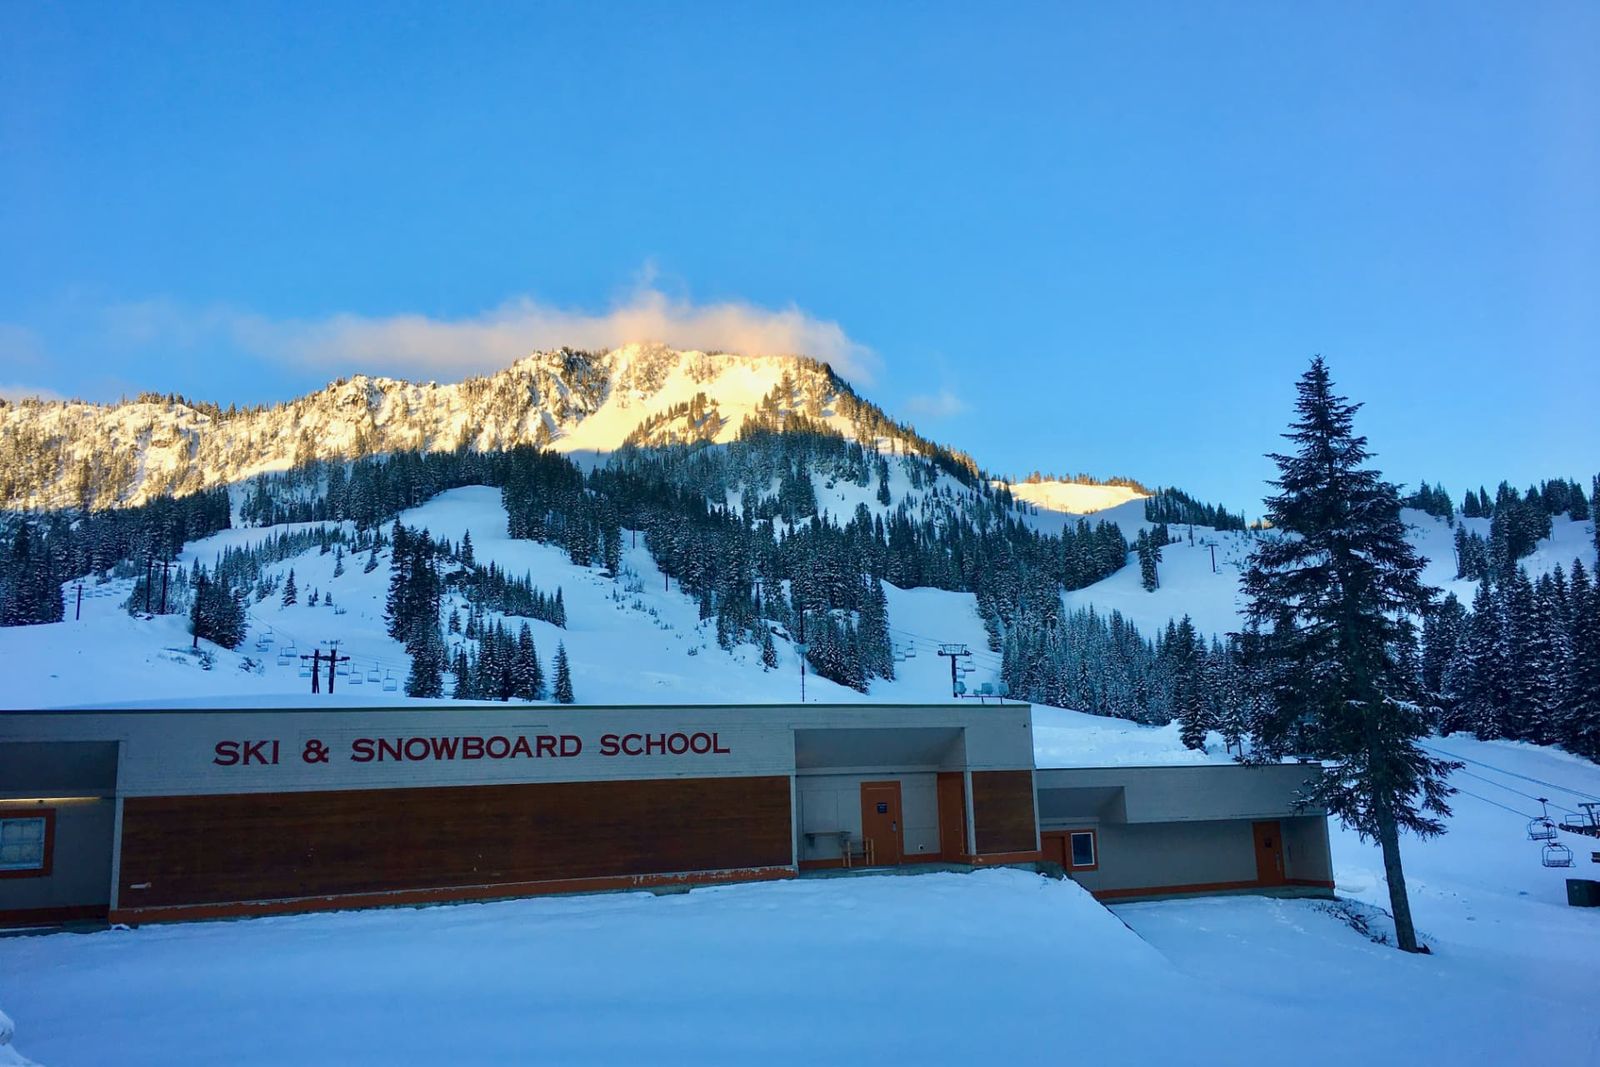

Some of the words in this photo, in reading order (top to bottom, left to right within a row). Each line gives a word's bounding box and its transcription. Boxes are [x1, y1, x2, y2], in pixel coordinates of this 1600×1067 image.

[213, 740, 279, 766] SKI
[302, 739, 329, 764] &
[350, 735, 582, 762] SNOWBOARD
[600, 732, 731, 756] SCHOOL
